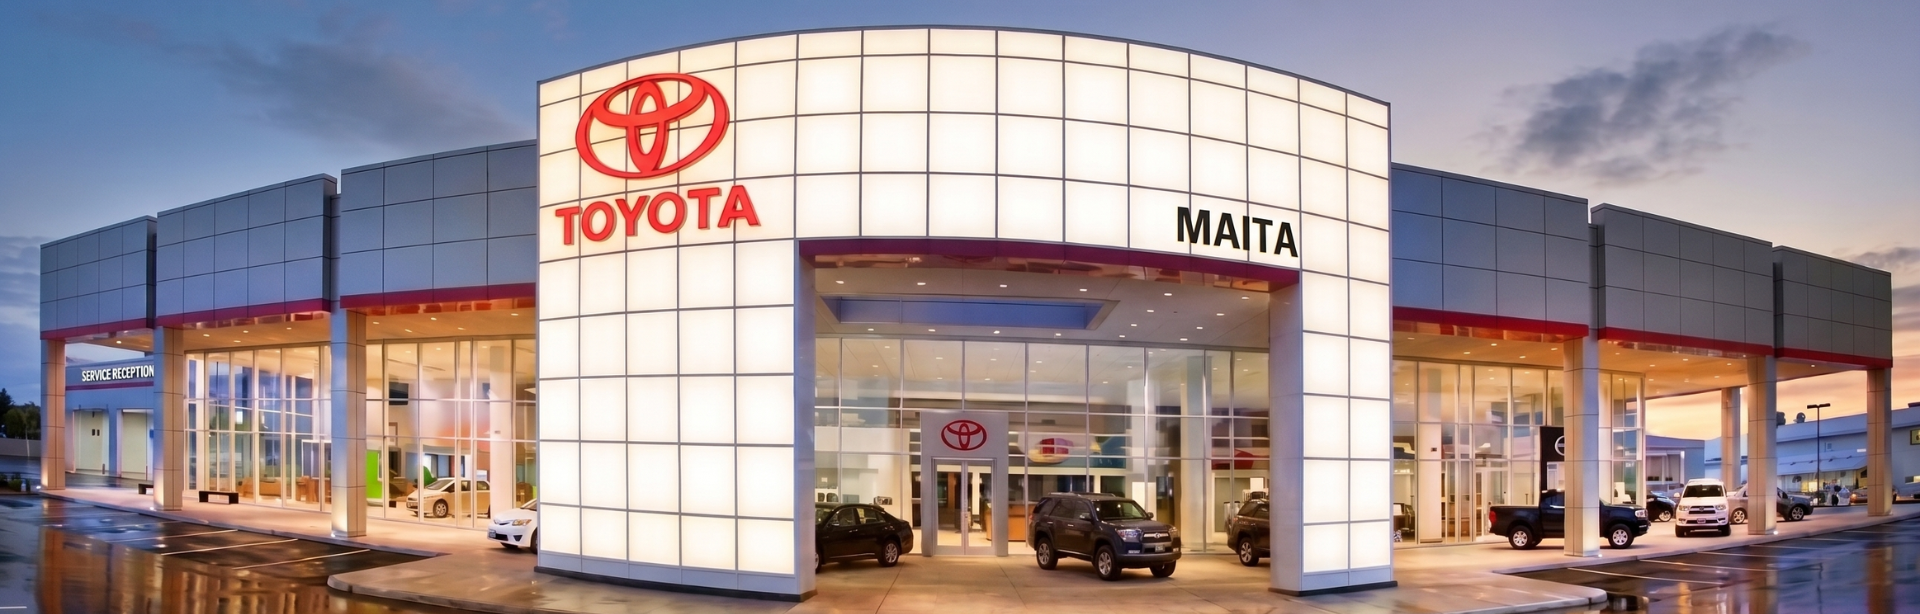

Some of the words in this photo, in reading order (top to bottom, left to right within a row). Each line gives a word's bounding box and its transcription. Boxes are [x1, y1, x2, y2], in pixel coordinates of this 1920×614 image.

[555, 184, 761, 245] TOYOTA
[1177, 206, 1299, 258] MAITA
[81, 368, 111, 382] SERVICE
[112, 365, 154, 380] RECEPTION
